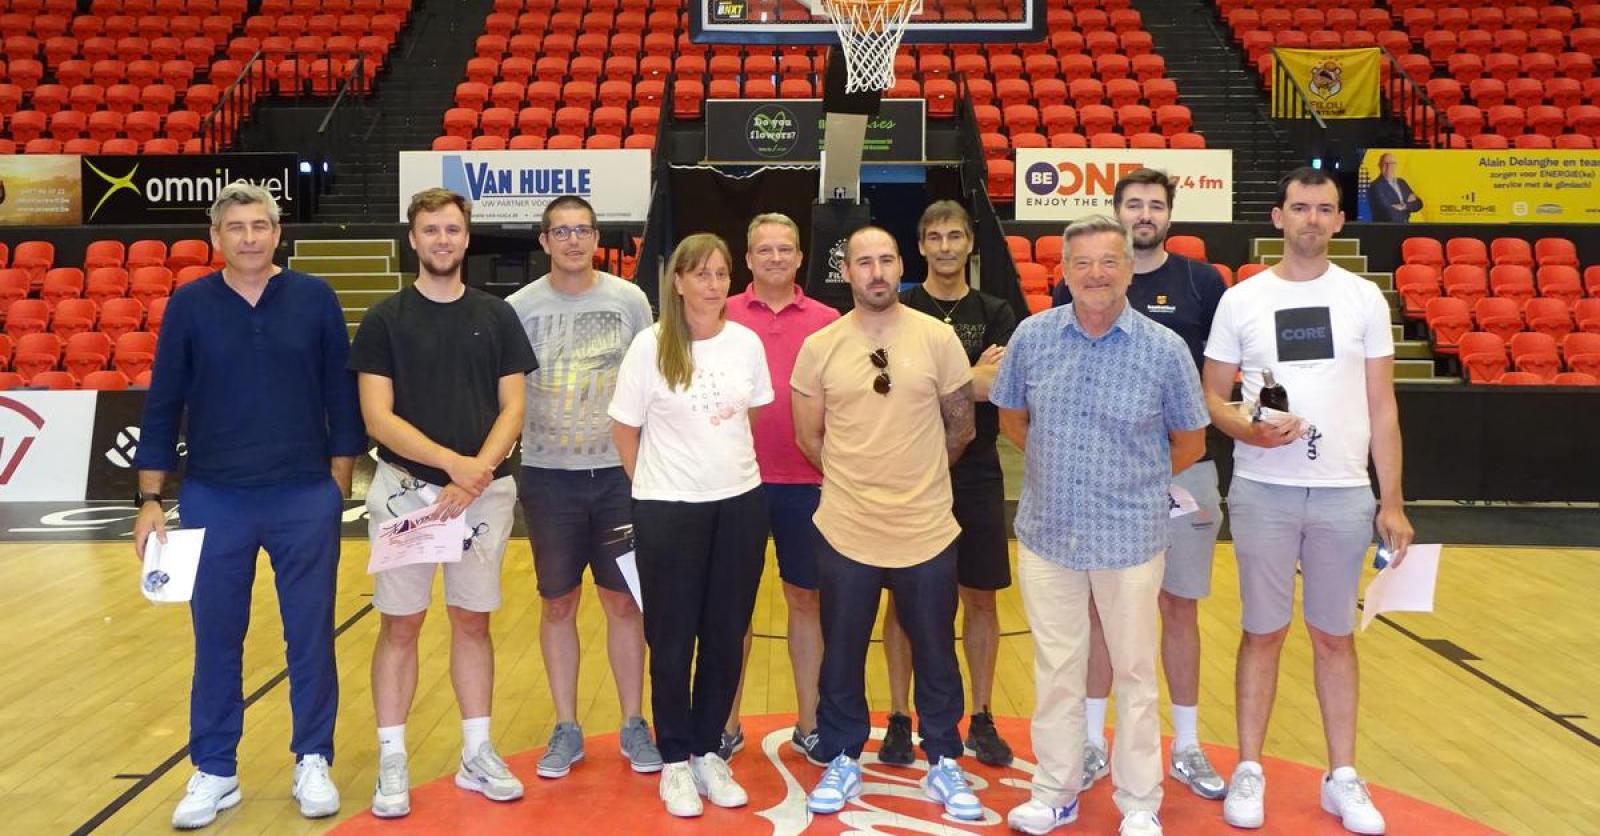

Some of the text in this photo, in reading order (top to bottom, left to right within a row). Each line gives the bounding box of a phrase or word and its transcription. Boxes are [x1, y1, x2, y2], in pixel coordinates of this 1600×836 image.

[754, 119, 792, 129] Do you
[750, 130, 797, 140] flowers?
[1479, 156, 1600, 168] Alain Delanghe en tea
[146, 168, 292, 202] omnilel
[519, 168, 591, 194] HUELE
[1031, 171, 1053, 185] BE
[1199, 175, 1224, 189] fm
[497, 200, 530, 208] PARTNER
[1281, 326, 1327, 341] CORE
